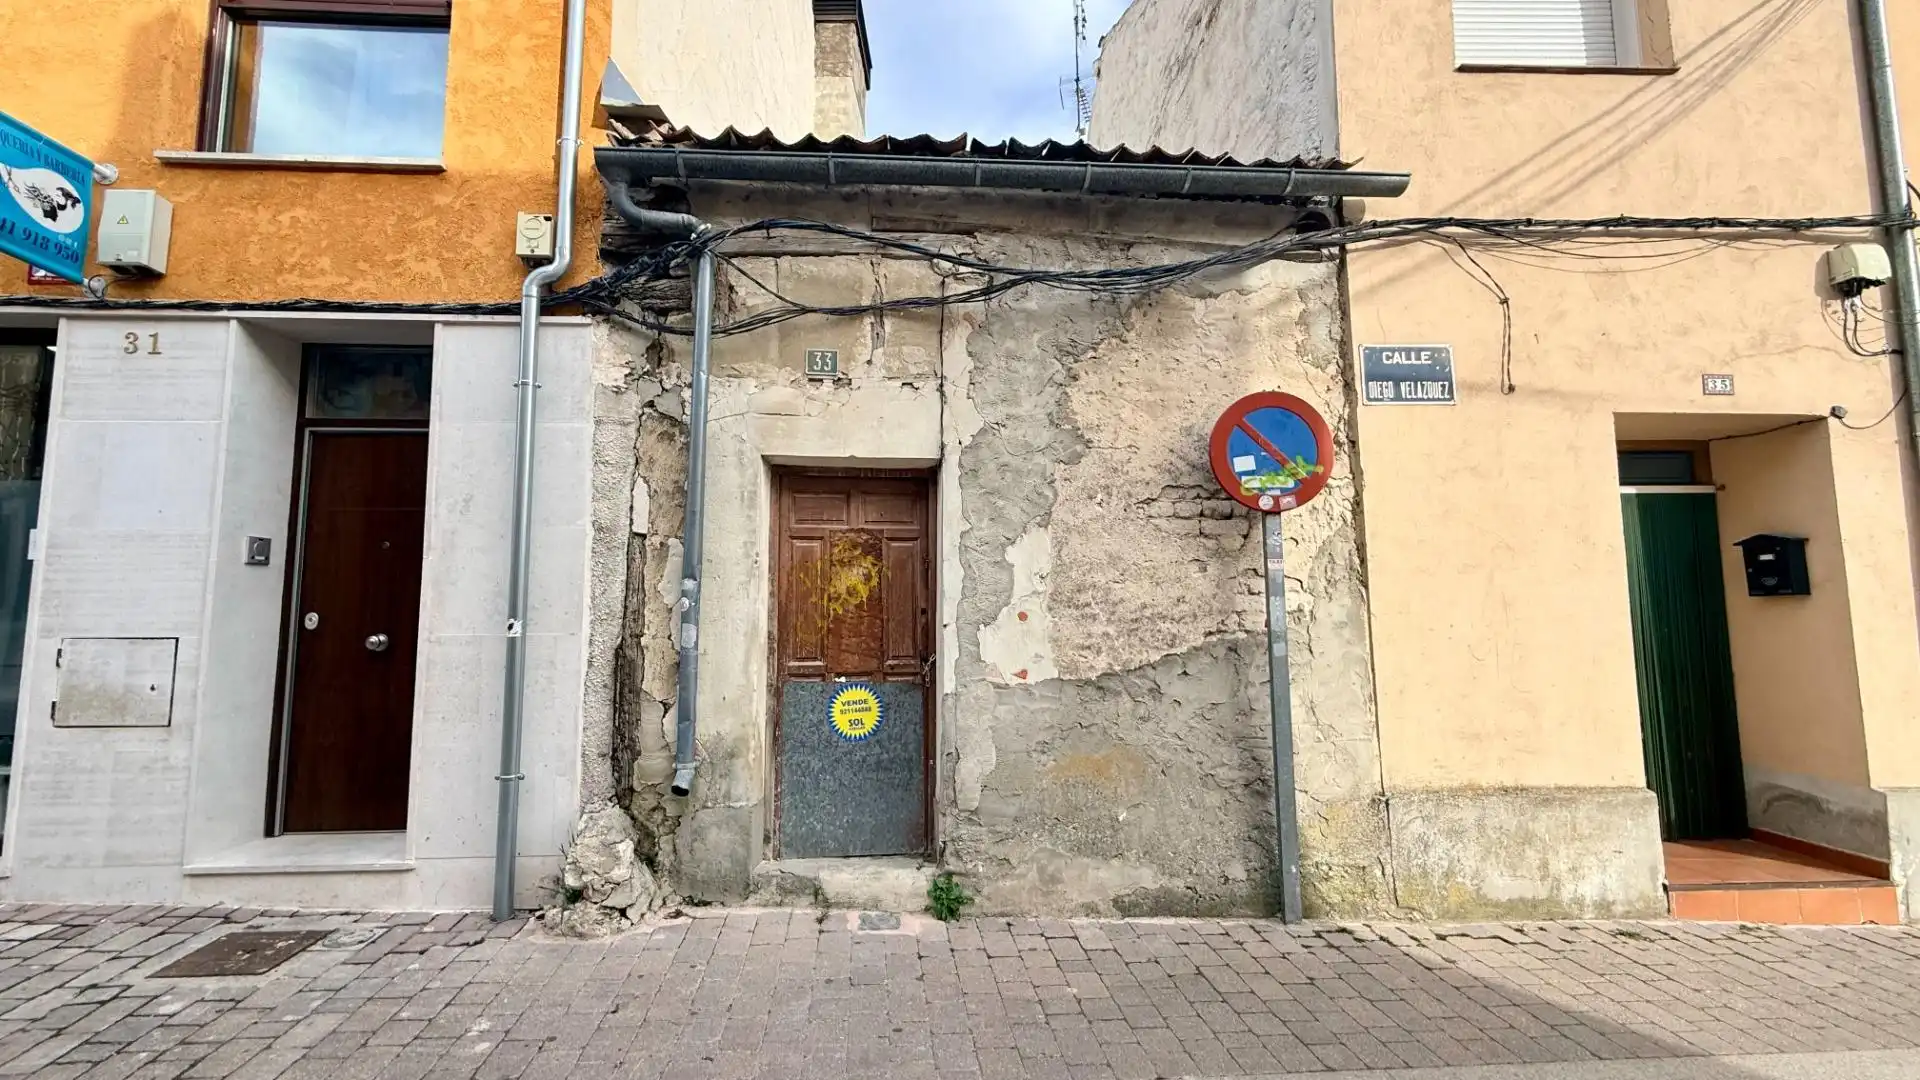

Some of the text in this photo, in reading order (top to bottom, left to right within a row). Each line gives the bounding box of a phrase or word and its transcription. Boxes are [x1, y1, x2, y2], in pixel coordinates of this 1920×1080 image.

[22, 227, 50, 251] 918
[54, 242, 80, 264] 950
[123, 331, 163, 355] 31
[813, 351, 832, 371] 33
[1382, 351, 1432, 364] CALLE
[1368, 381, 1450, 399] DIEGO VELAZQUEZ
[1709, 379, 1728, 390] 35
[841, 699, 868, 707] VENDE
[848, 718, 865, 727] SOL
